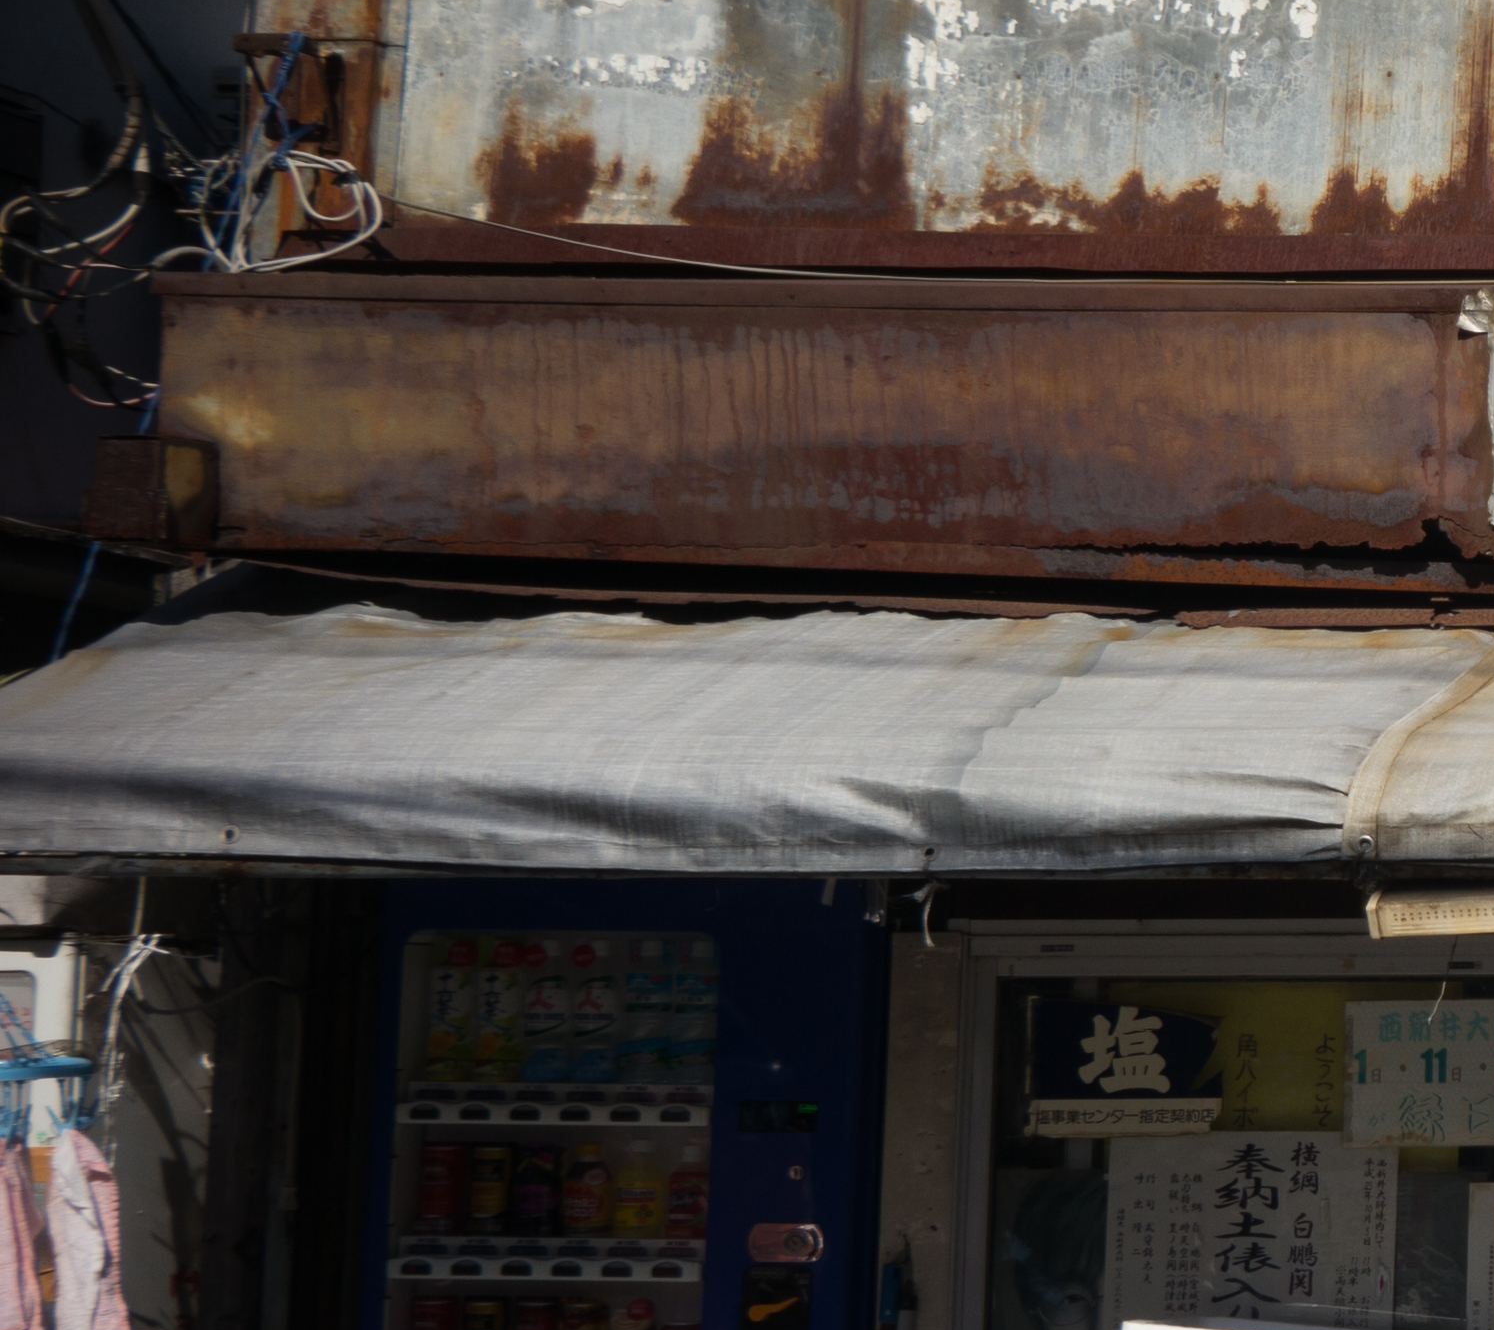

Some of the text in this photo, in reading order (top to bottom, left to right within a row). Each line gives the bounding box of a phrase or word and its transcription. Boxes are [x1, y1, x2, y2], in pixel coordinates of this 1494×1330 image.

[1079, 1006, 1171, 1095] 塩
[1313, 1034, 1337, 1127] ようこそ
[1036, 1109, 1215, 1126] 塩事業センター指定契約店
[1288, 1141, 1320, 1195] 横綱
